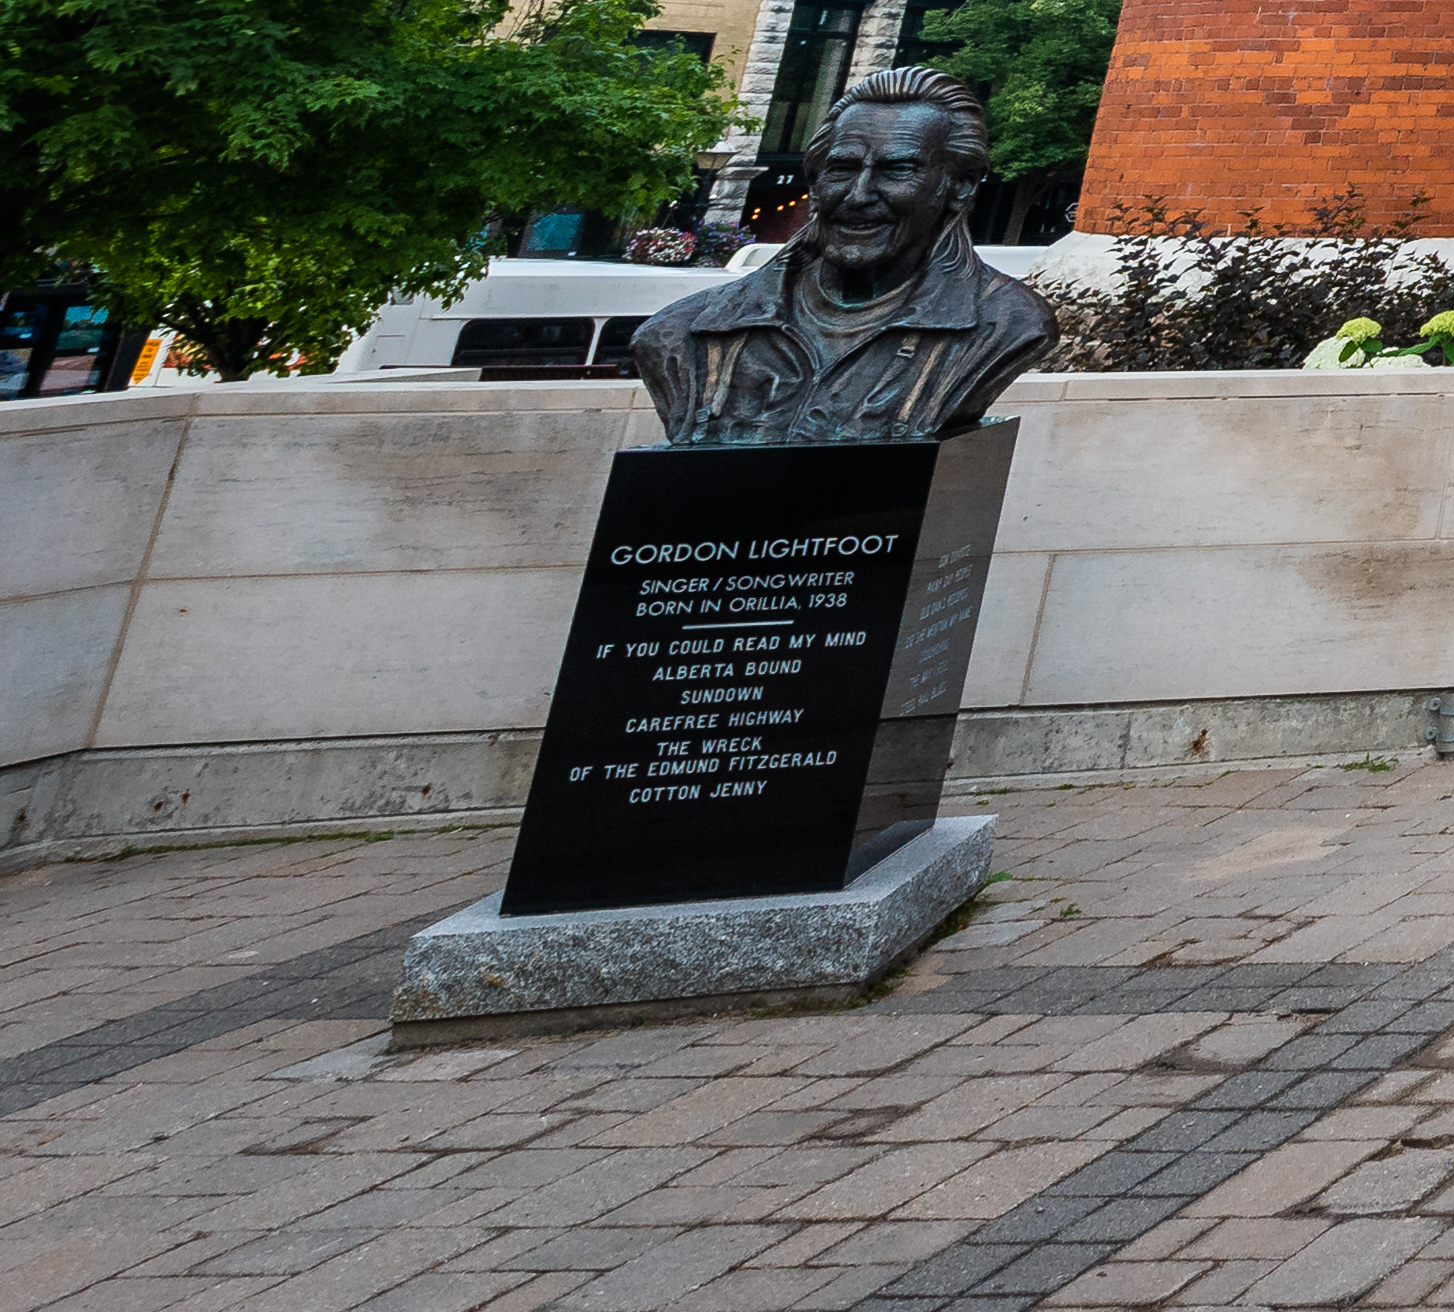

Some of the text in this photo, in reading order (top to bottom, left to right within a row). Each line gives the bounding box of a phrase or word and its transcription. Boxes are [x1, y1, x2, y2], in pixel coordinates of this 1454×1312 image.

[777, 175, 794, 184] 27
[611, 535, 898, 565] GORDON LIGHTFOOT
[639, 572, 854, 595] SINGER SONGWRITER
[636, 593, 847, 616] BORN IN ORILLIA, 1938
[597, 632, 866, 658] IF YOU COULD READ MY MIND
[653, 659, 801, 681] ALBERTA BOUND
[680, 687, 763, 704] SUNDOWN
[625, 709, 804, 733] CAREFREE HIGHWAY
[657, 737, 762, 756] THE WRECK
[570, 751, 837, 782] OF THE EDMUND FITZGERALD
[629, 781, 767, 803] COTTON JENNY
